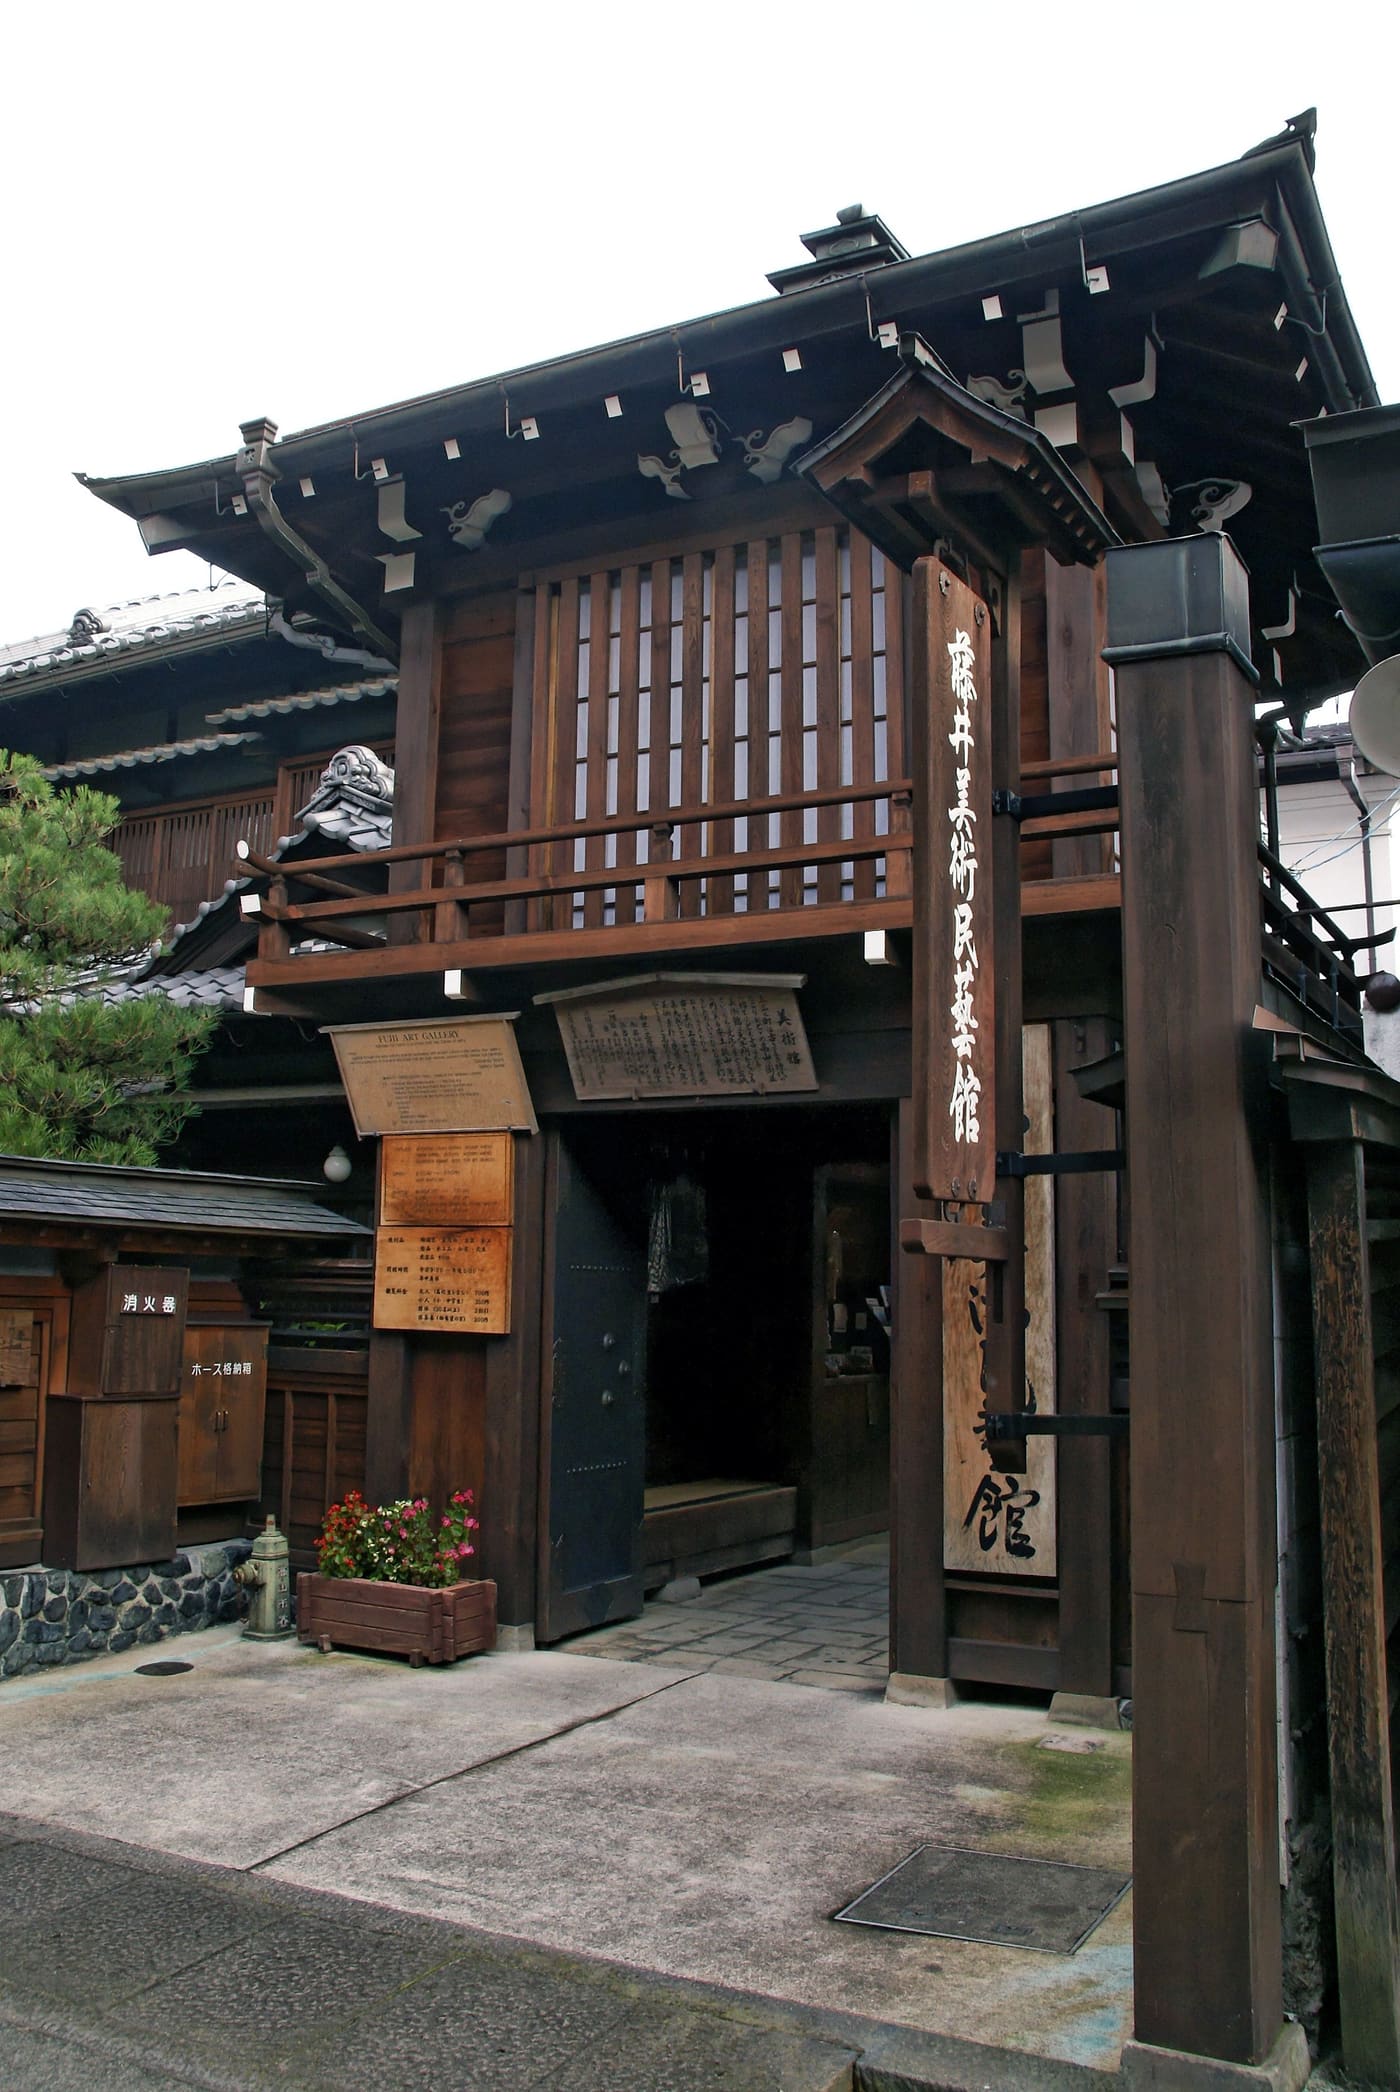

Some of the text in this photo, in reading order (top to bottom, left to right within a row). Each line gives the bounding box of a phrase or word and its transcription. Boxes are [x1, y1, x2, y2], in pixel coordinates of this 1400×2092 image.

[947, 628, 980, 1145] 藤井美術民藝館
[402, 1032, 418, 1042] ART
[422, 1030, 459, 1041] GALLERY
[123, 1293, 177, 1313] 消火器
[191, 1361, 253, 1376] ホース格納箱
